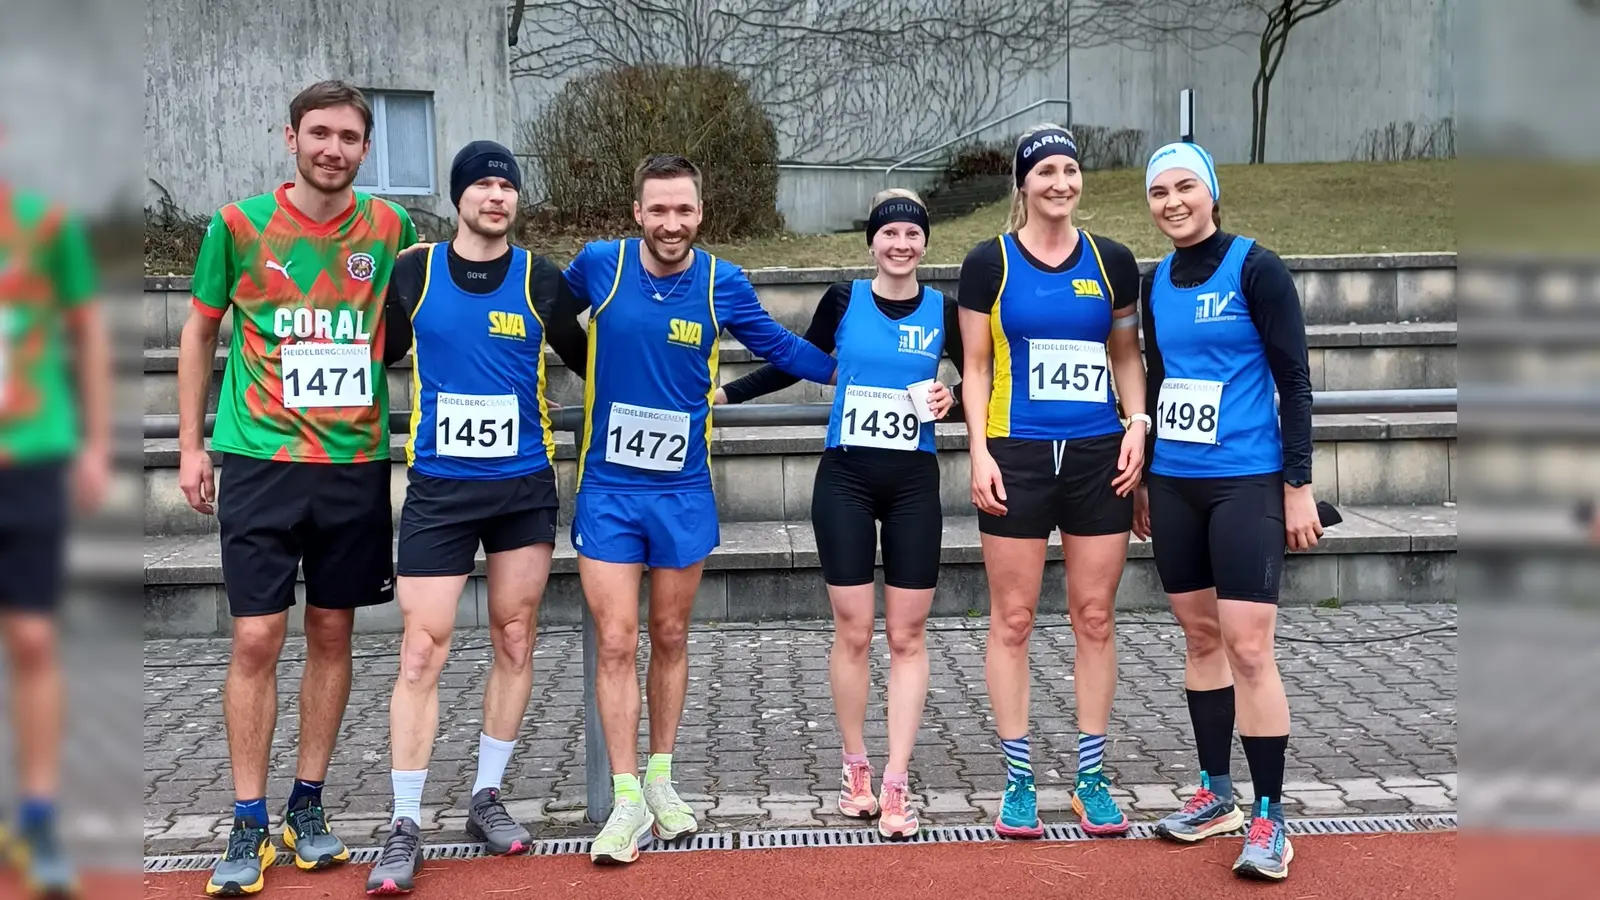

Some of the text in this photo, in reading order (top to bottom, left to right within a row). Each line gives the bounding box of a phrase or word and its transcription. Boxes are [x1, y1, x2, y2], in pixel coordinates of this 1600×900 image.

[488, 160, 509, 171] GORE
[879, 203, 920, 218] KIPRUN
[467, 271, 488, 279] GORE
[1072, 278, 1104, 298] SVA
[273, 307, 371, 340] CORAL
[488, 310, 527, 338] SVA
[668, 318, 703, 346] SVA
[283, 347, 368, 357] HEIDELBERGCEMENT
[285, 367, 367, 397] 1471
[1031, 362, 1106, 392] 1457
[612, 405, 688, 423] HEIDELBERGCEMENT
[844, 408, 919, 441] 1439
[1158, 401, 1216, 433] 1498
[439, 416, 513, 447] 1451
[610, 426, 686, 462] 1472
